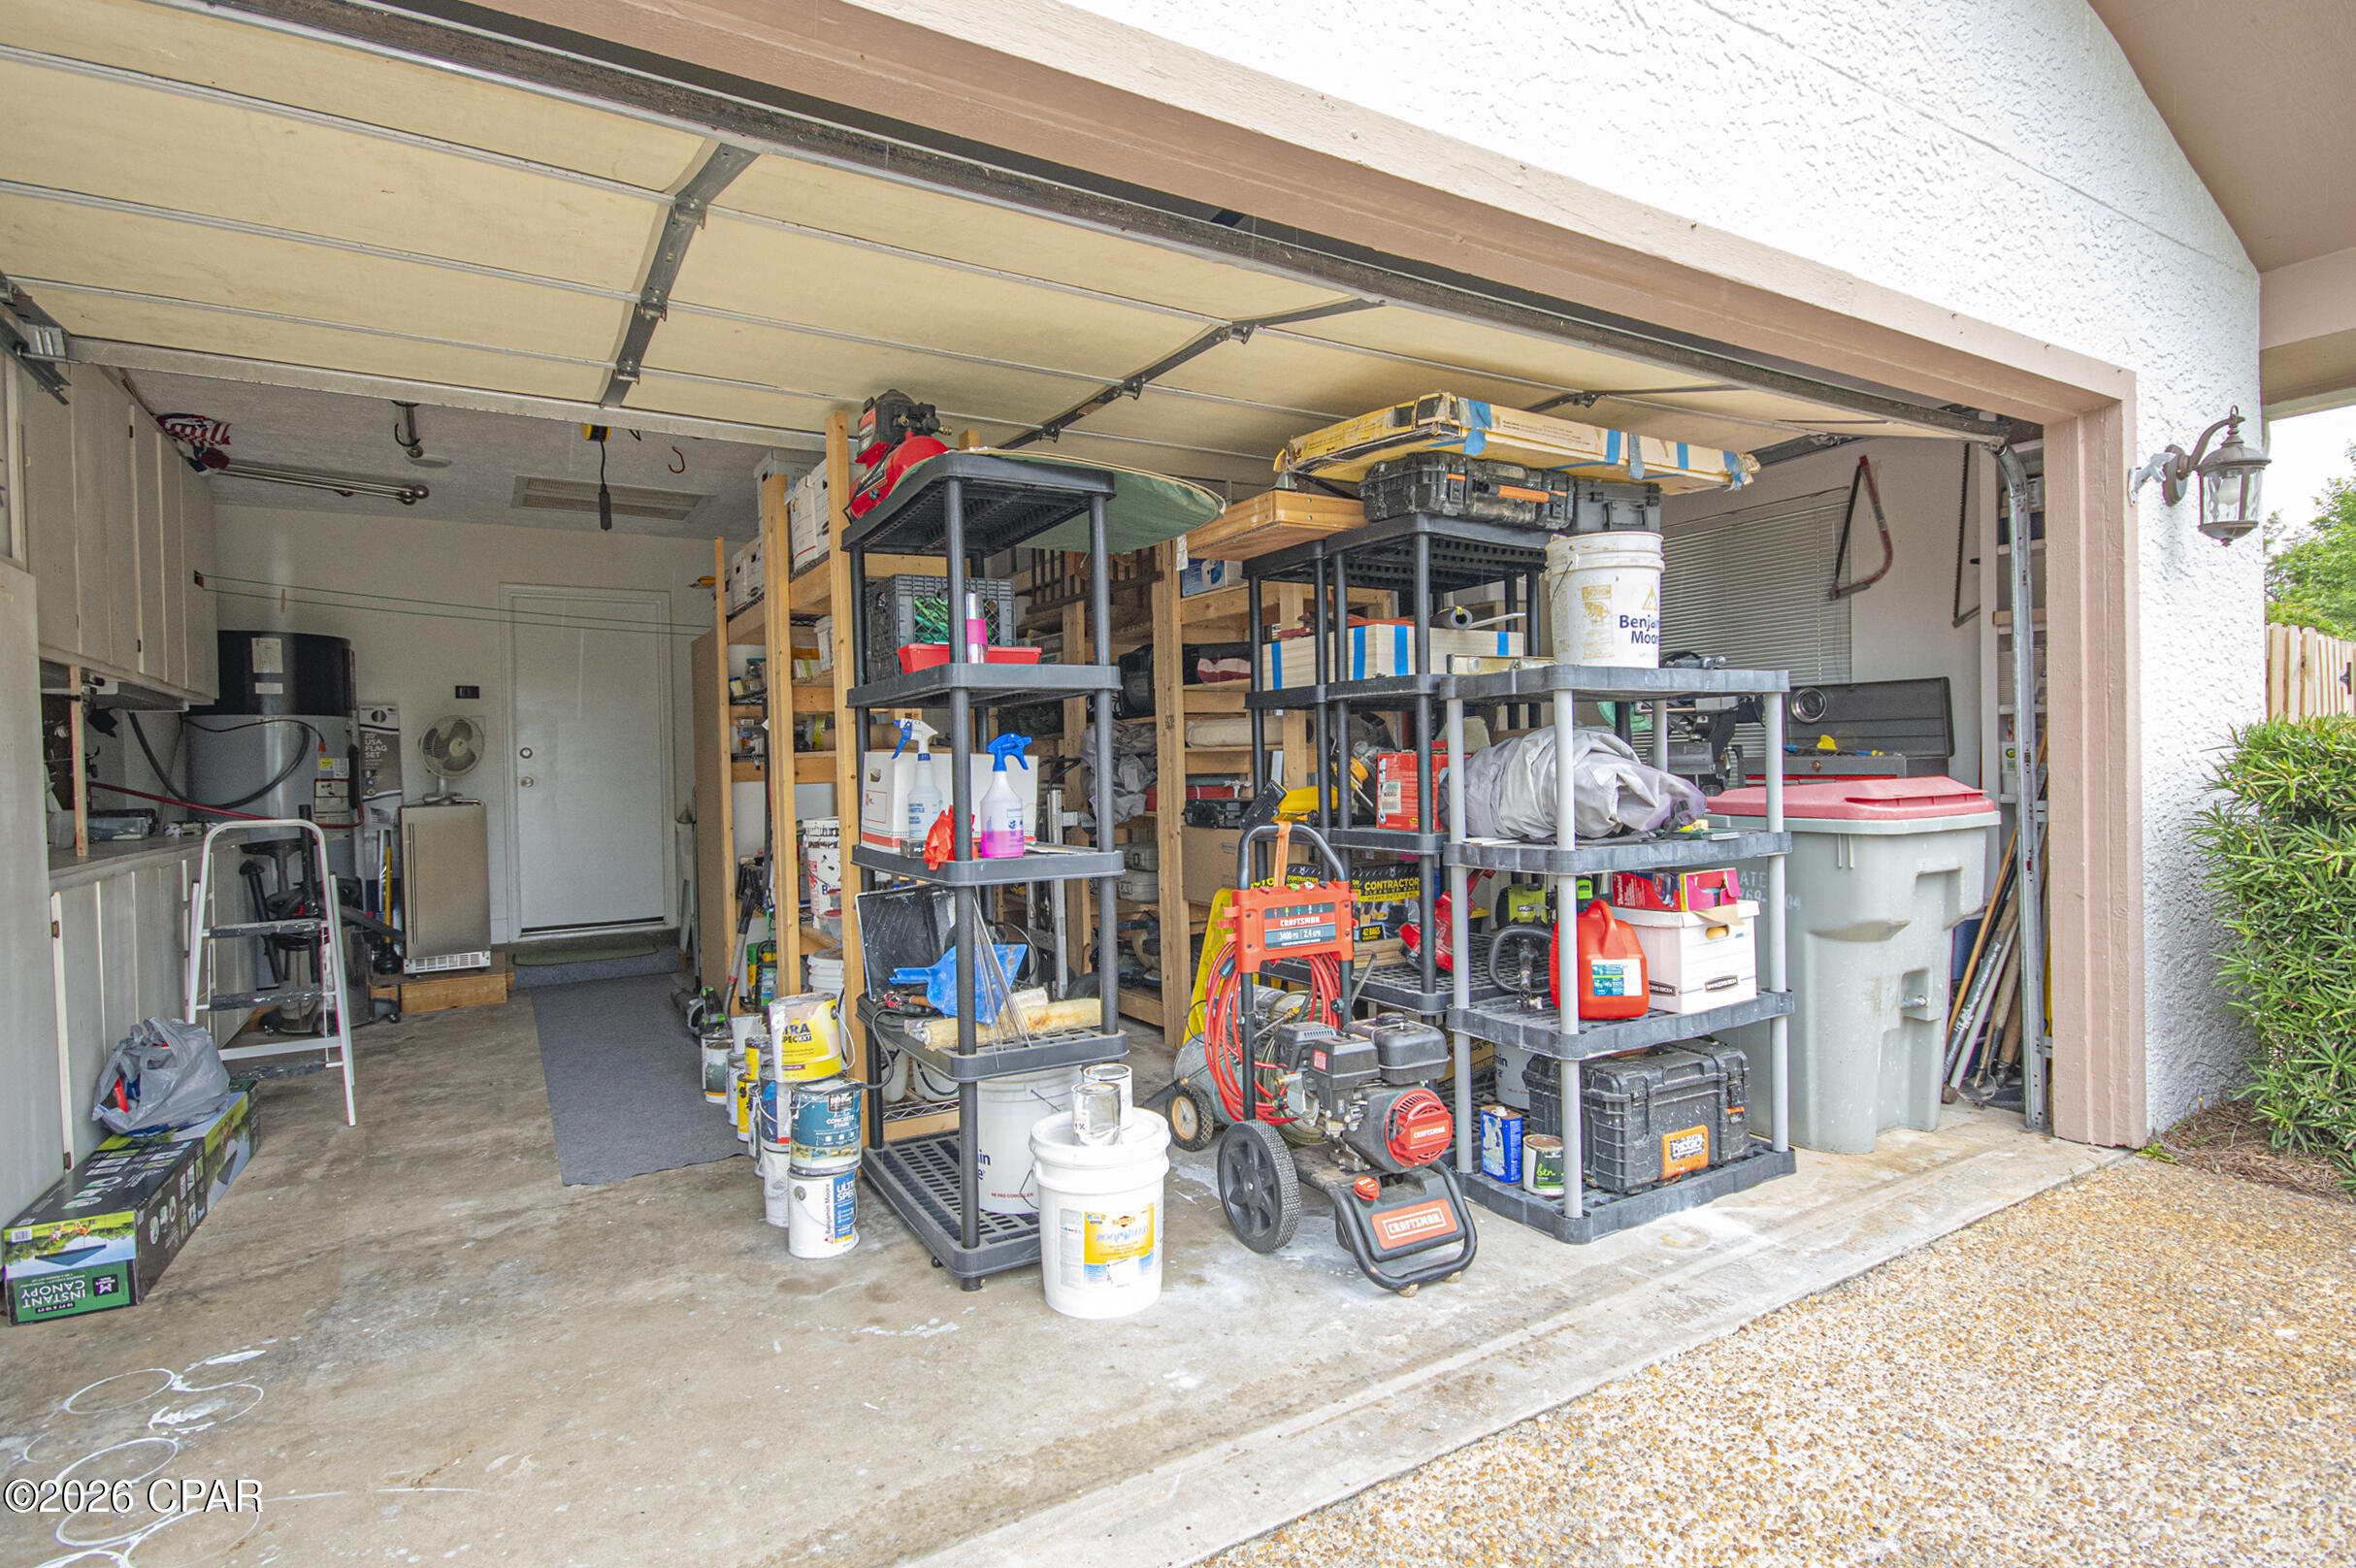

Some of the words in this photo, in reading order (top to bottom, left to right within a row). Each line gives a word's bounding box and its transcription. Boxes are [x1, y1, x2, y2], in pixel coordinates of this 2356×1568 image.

[1364, 877, 1420, 891] CONTRACTOR
[1280, 916, 1321, 928] CRAFTSMAN
[1362, 928, 1369, 936] 42
[1369, 926, 1381, 936] BAGS
[1413, 1126, 1446, 1139] CRAFTSMAN
[1536, 1162, 1555, 1177] ben
[1388, 1213, 1443, 1235] CRAFTSMAN
[20, 1280, 86, 1299] CANOPY
[22, 1290, 86, 1309] INSTANT
